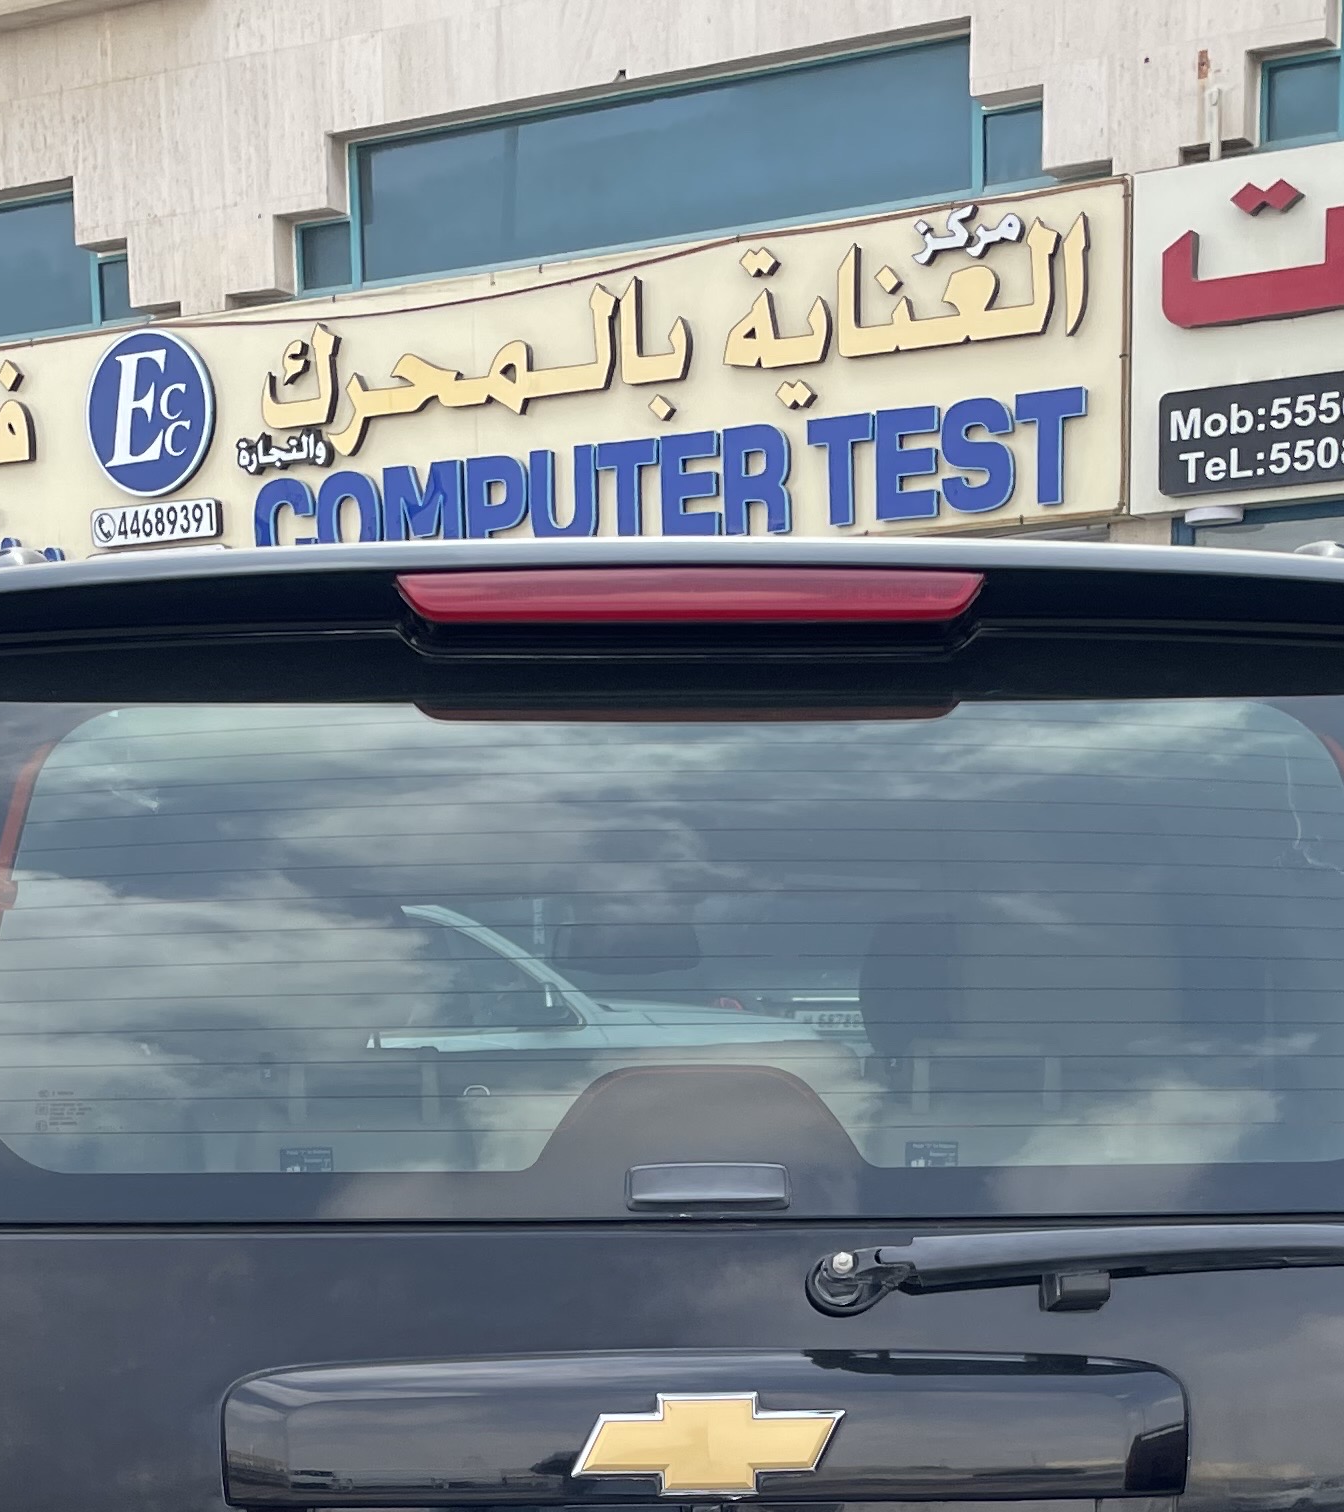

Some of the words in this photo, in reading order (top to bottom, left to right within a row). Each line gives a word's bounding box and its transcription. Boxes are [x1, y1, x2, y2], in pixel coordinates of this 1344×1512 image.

[724, 211, 1090, 409] العناية
[912, 205, 1025, 266] مركز
[262, 276, 694, 456] بالمحرك
[117, 503, 215, 539] 44689391
[255, 423, 792, 548] COMPUTER
[808, 386, 1089, 526] TEST
